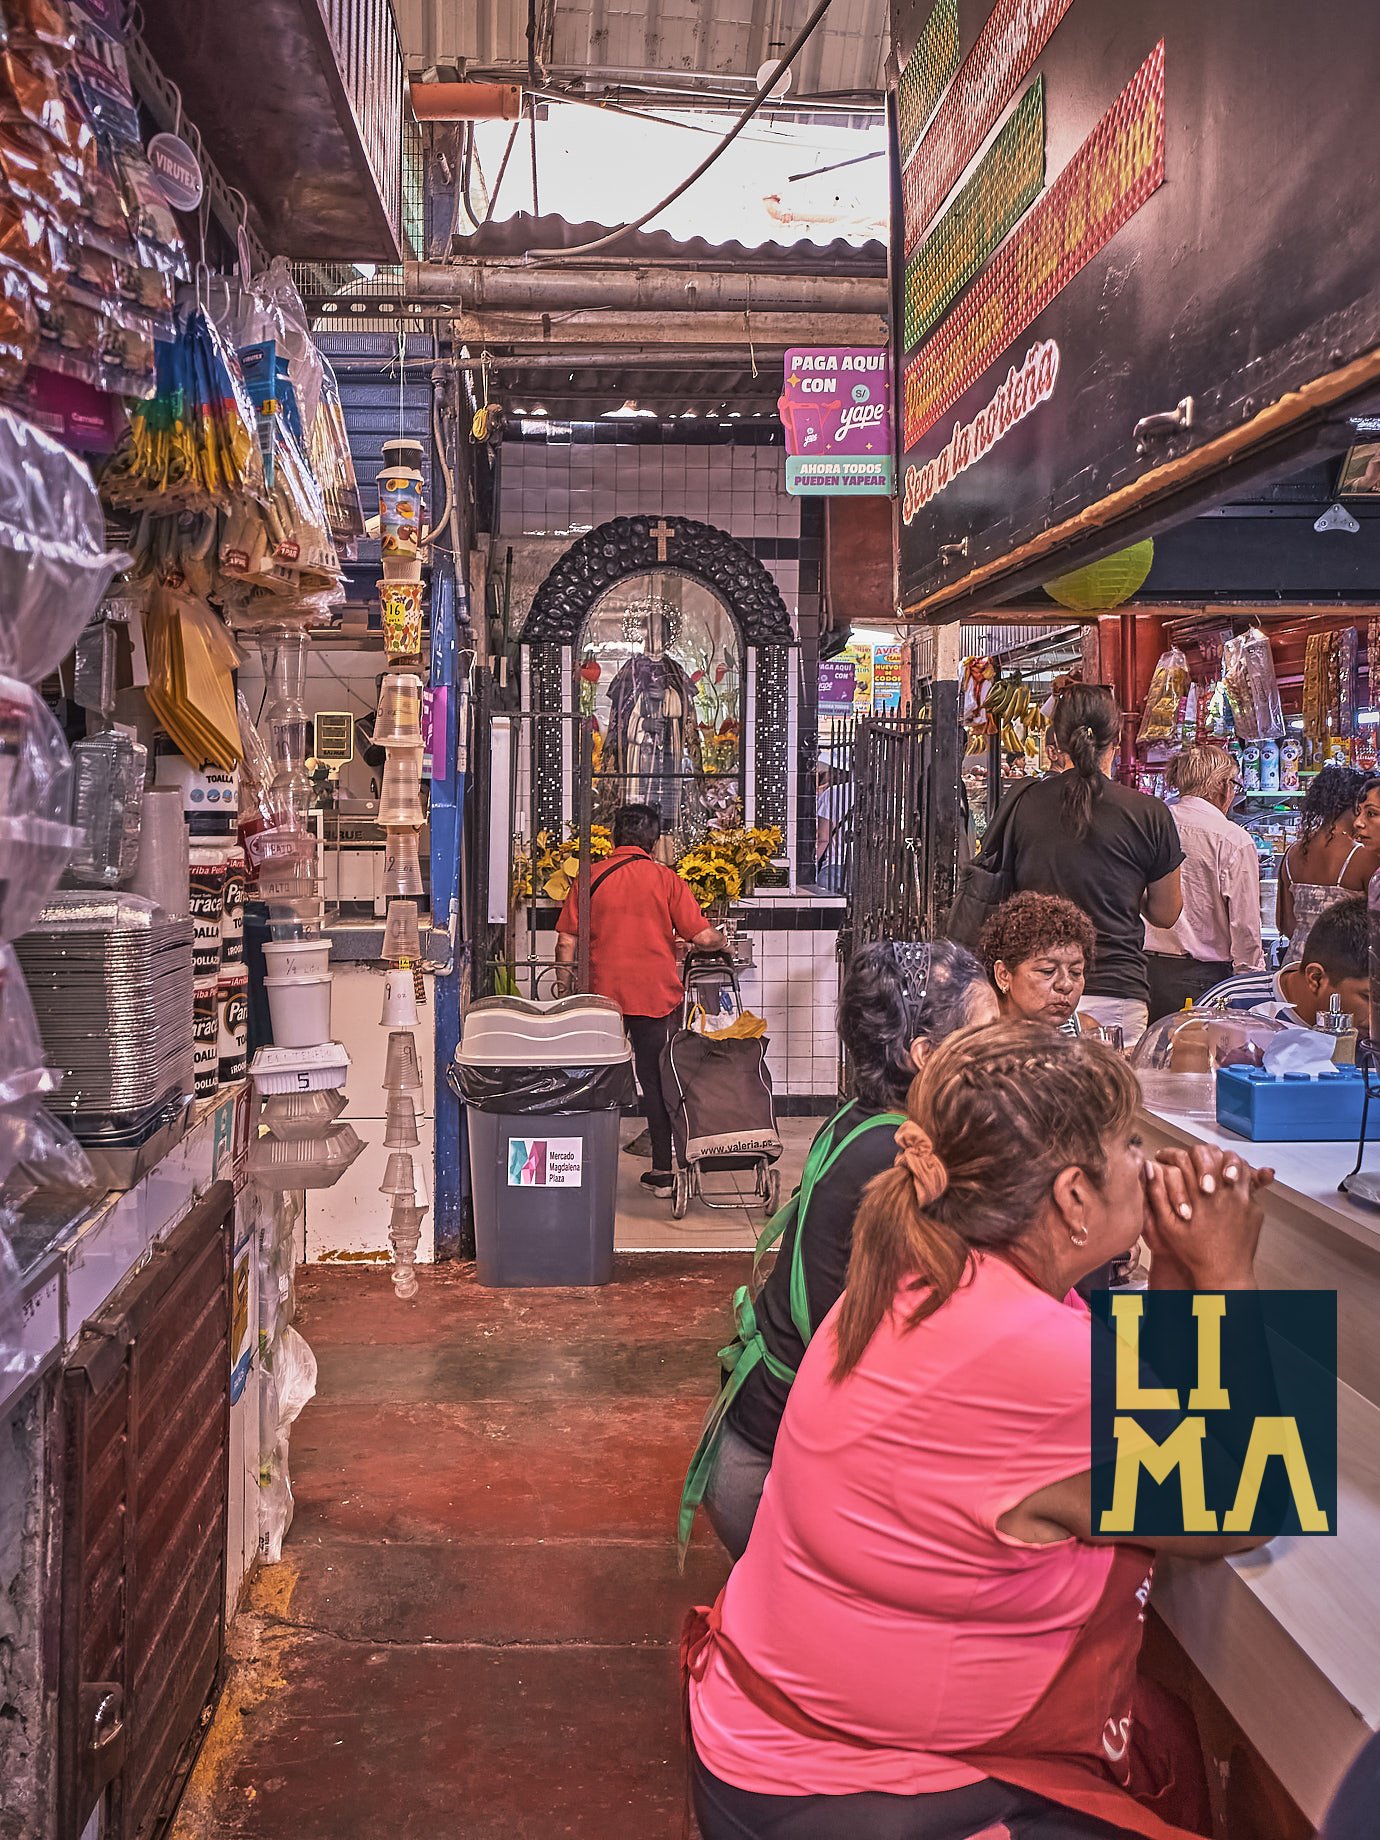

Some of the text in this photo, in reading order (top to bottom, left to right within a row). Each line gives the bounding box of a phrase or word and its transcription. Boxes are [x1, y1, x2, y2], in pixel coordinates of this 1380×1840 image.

[156, 151, 196, 191] VIRUTEX
[791, 352, 886, 372] PAGA AQUÍ
[802, 378, 836, 392] CON
[834, 404, 884, 442] yape
[903, 343, 1054, 519] Seco a la norteña
[800, 464, 882, 474] AHORA TODOS
[794, 476, 886, 486] PUEDEN YAPEAR
[390, 604, 400, 616] 16
[876, 648, 901, 656] AVIC
[206, 774, 233, 784] TOALLA
[386, 983, 391, 1000] 9
[298, 1073, 309, 1089] 5
[550, 1152, 574, 1161] Mercado
[550, 1163, 580, 1173] Magdalena
[549, 1174, 564, 1182] Plaza
